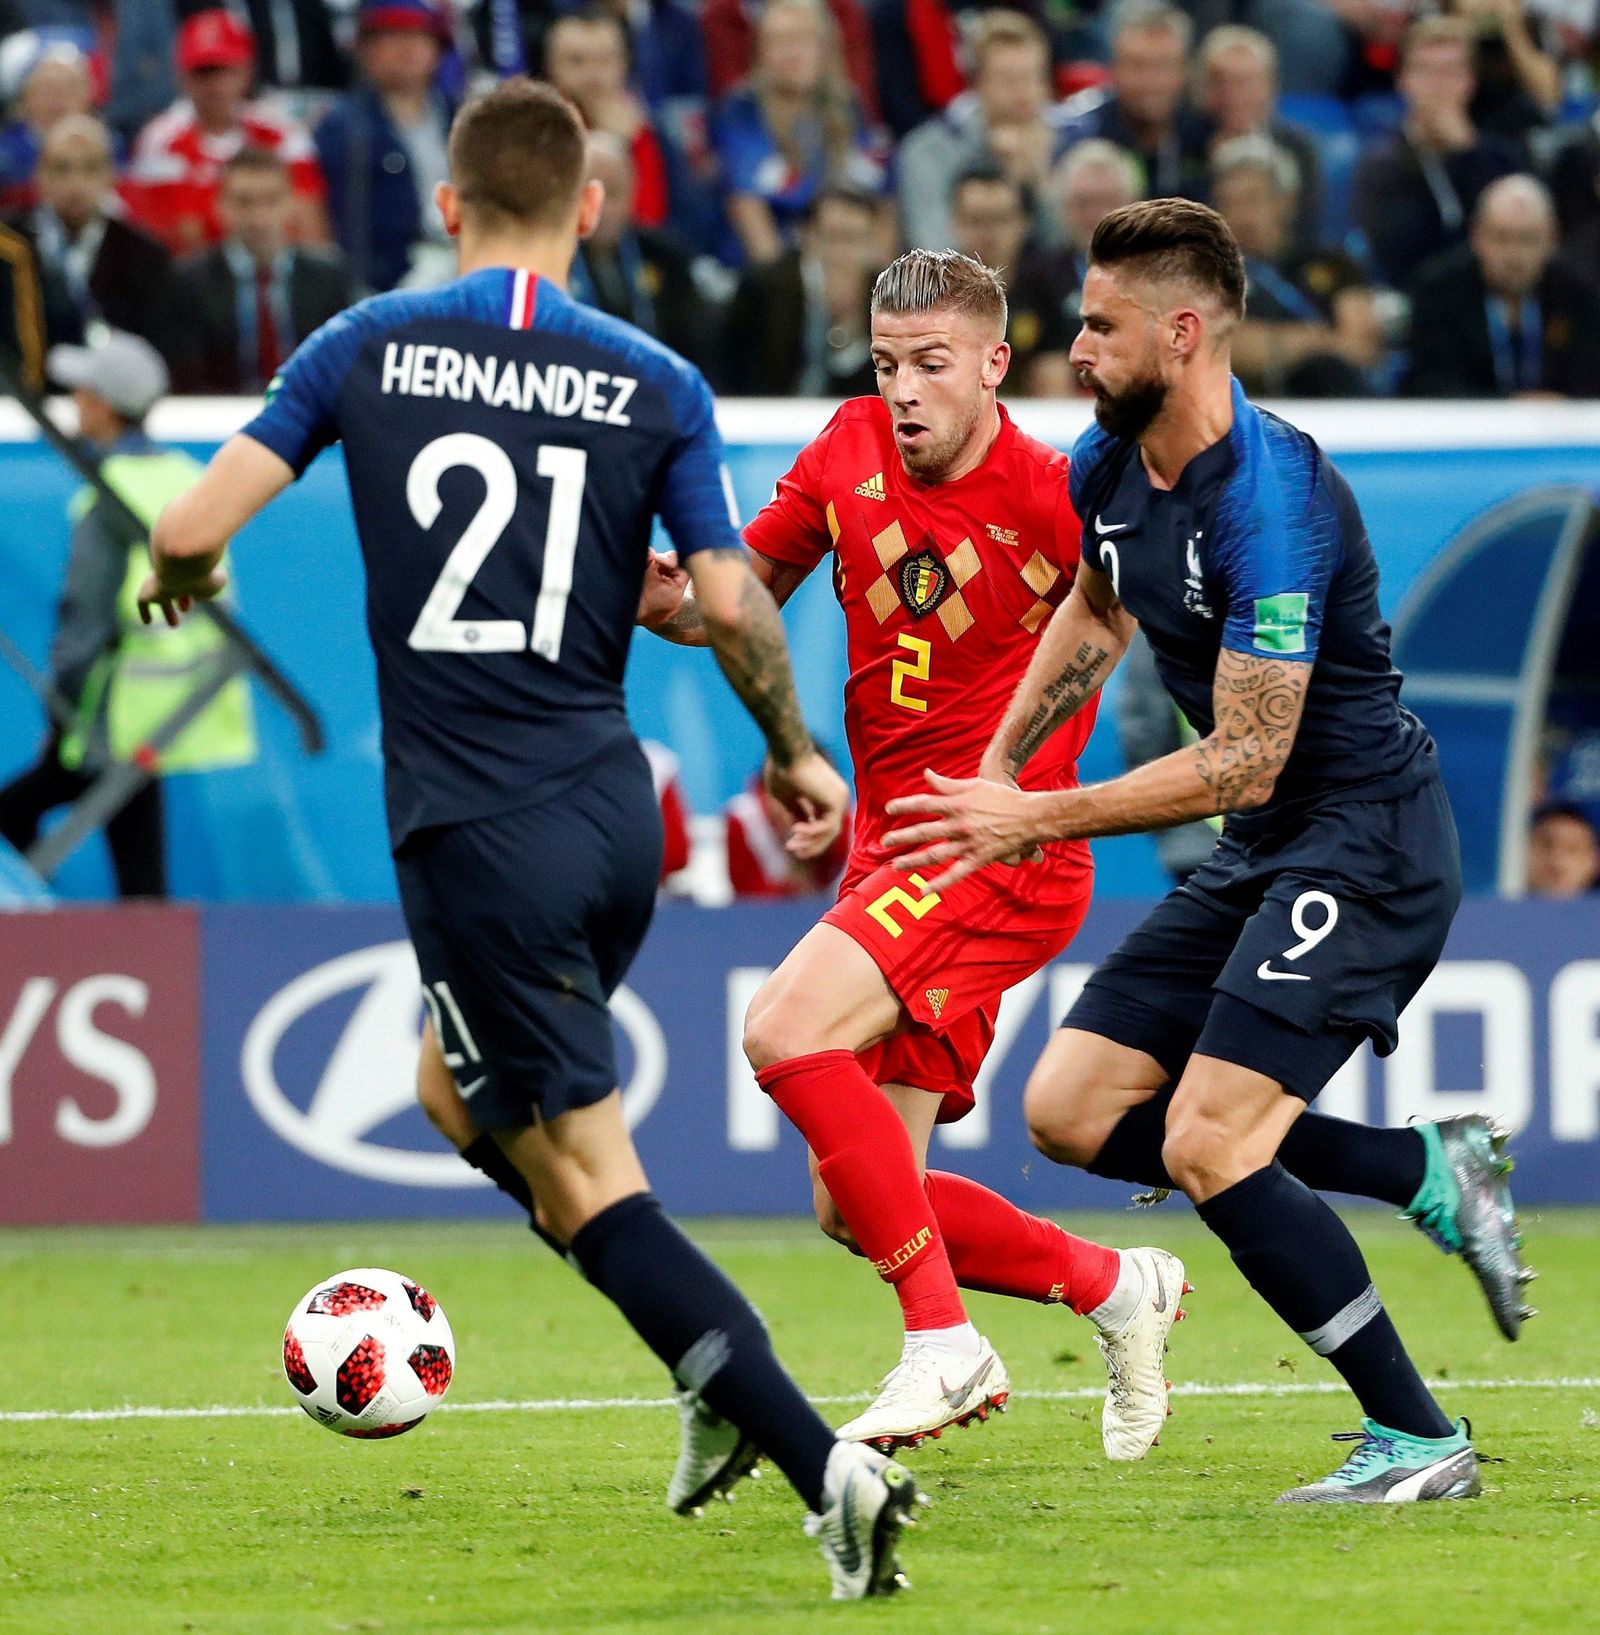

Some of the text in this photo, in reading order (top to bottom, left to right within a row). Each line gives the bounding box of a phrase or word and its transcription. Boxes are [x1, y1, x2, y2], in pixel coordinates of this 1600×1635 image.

[381, 342, 638, 427] HERNANDEZ
[854, 486, 887, 502] adidas
[406, 432, 587, 663] 21
[891, 632, 931, 713] 2
[865, 873, 942, 939] 2
[1282, 889, 1339, 961] 9
